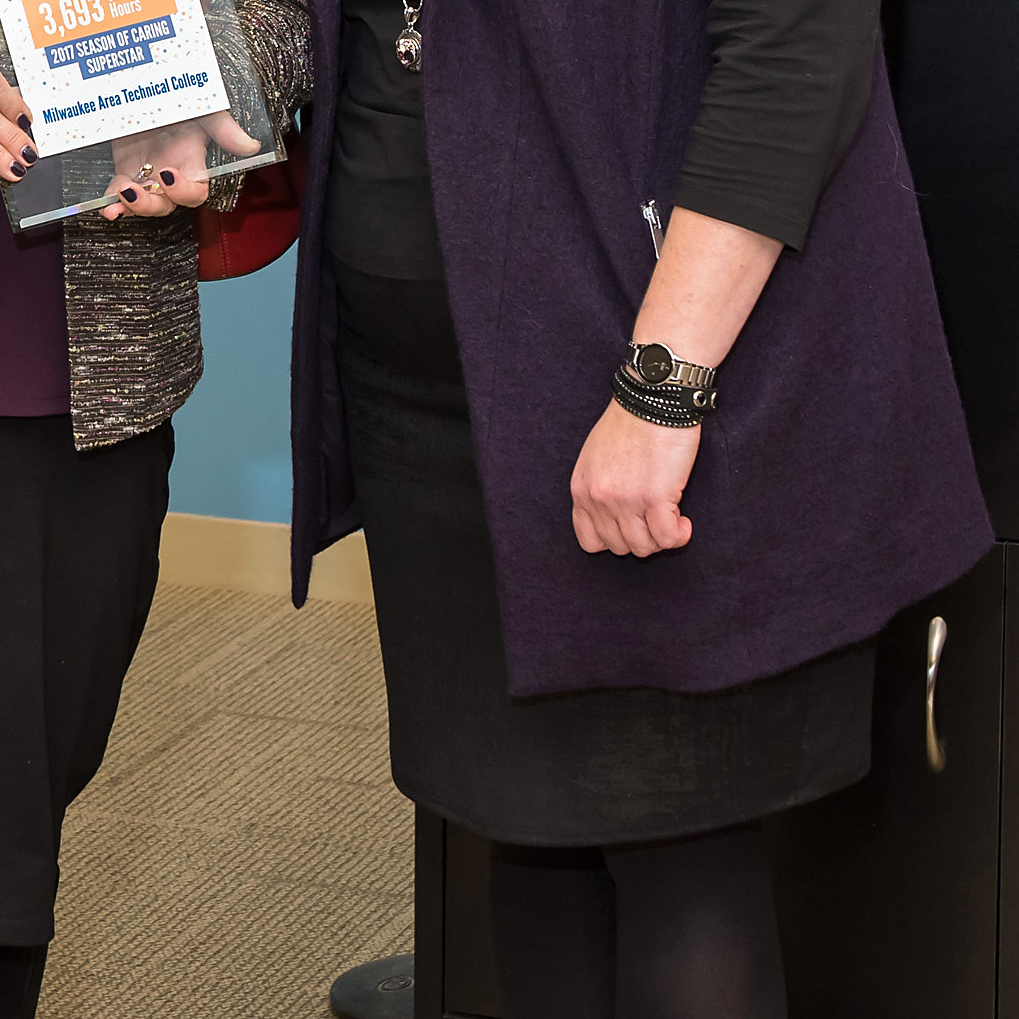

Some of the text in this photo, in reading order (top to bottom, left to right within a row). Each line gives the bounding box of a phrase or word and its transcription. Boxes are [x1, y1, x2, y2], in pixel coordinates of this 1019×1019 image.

[108, 0, 142, 18] Hours
[51, 20, 170, 64] 2017 SEASON OF CARING
[86, 46, 145, 74] SUPERSTAR
[43, 72, 208, 124] Milwaukee Area Technical College
